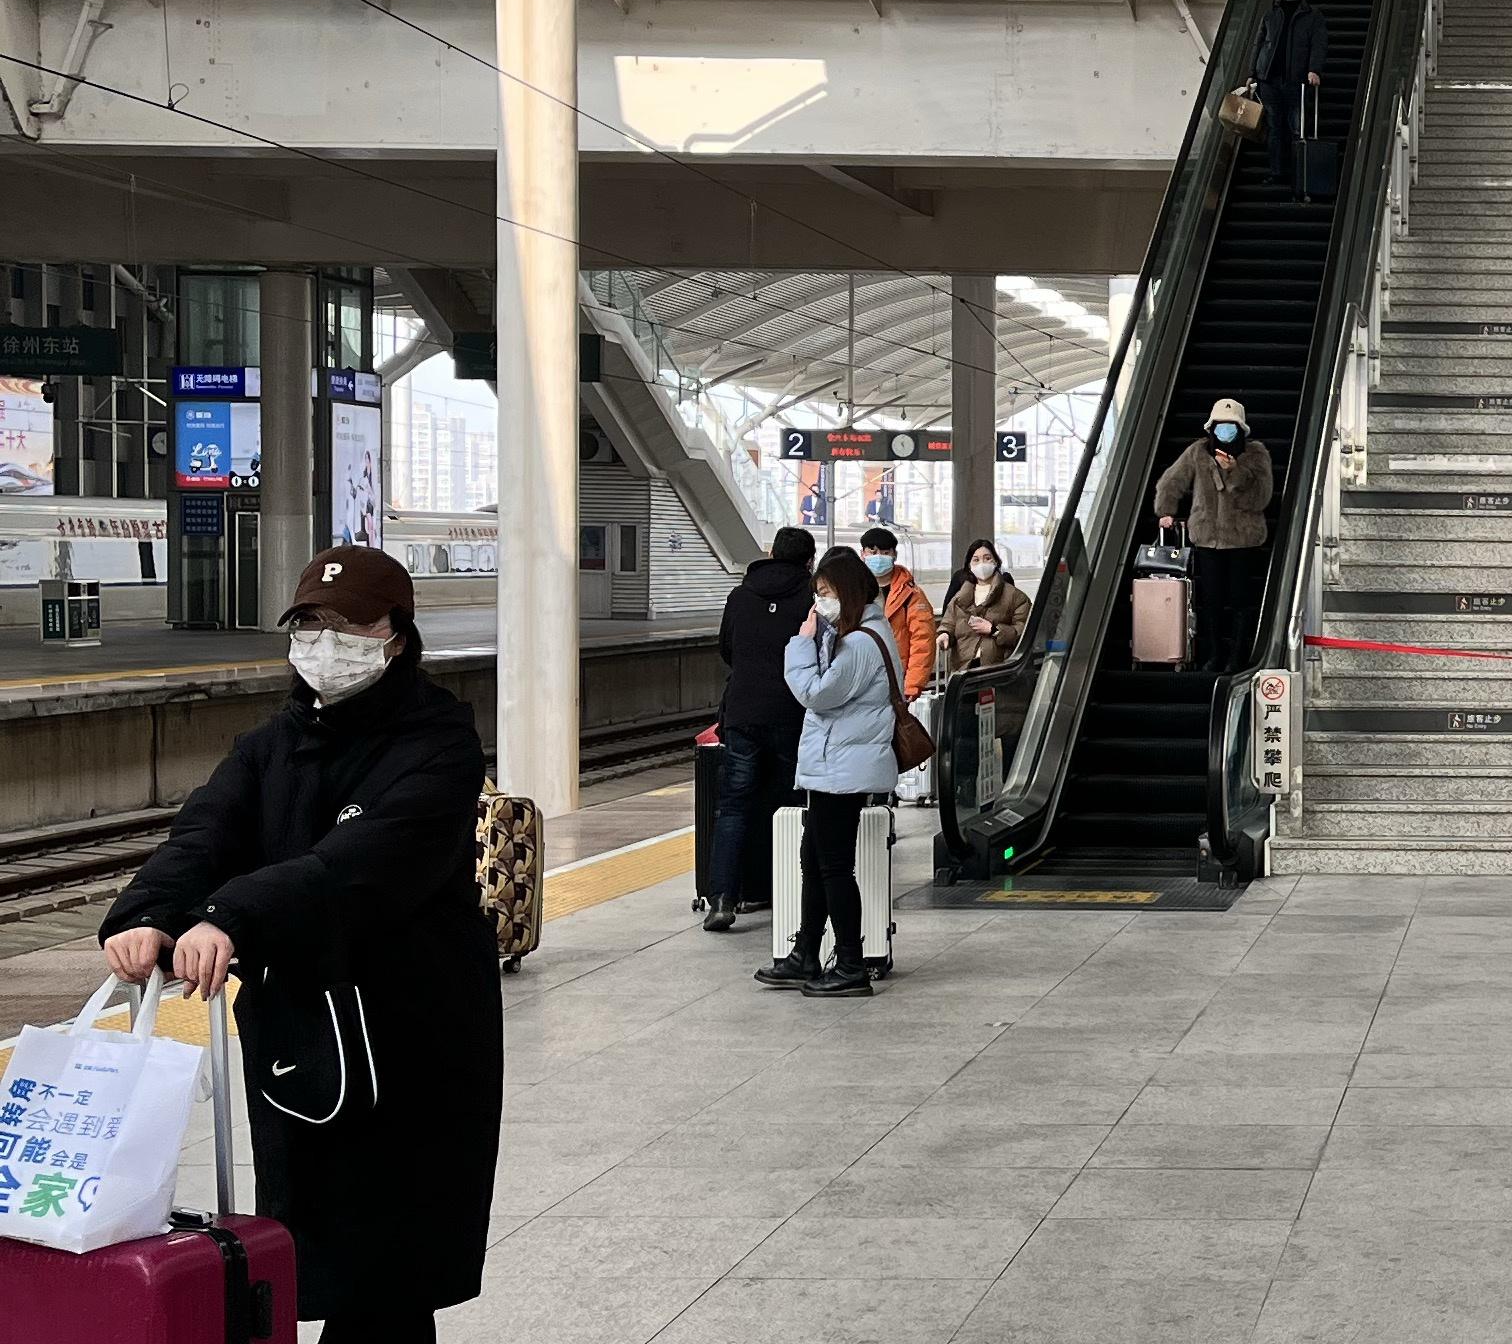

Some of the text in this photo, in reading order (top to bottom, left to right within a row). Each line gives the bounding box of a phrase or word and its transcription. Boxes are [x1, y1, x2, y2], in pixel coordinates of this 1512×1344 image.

[3, 336, 80, 354] 徐州东站
[788, 433, 804, 456] 2
[1002, 435, 1018, 458] 3
[321, 563, 343, 582] P
[1473, 597, 1506, 606] 旅客止步
[1466, 714, 1502, 724] 旅客止步
[1264, 704, 1282, 788] 严禁攀爬
[38, 1082, 93, 1105] 不一定
[26, 1107, 123, 1140] 会遇到爱
[0, 1131, 88, 1170] 可能 会是
